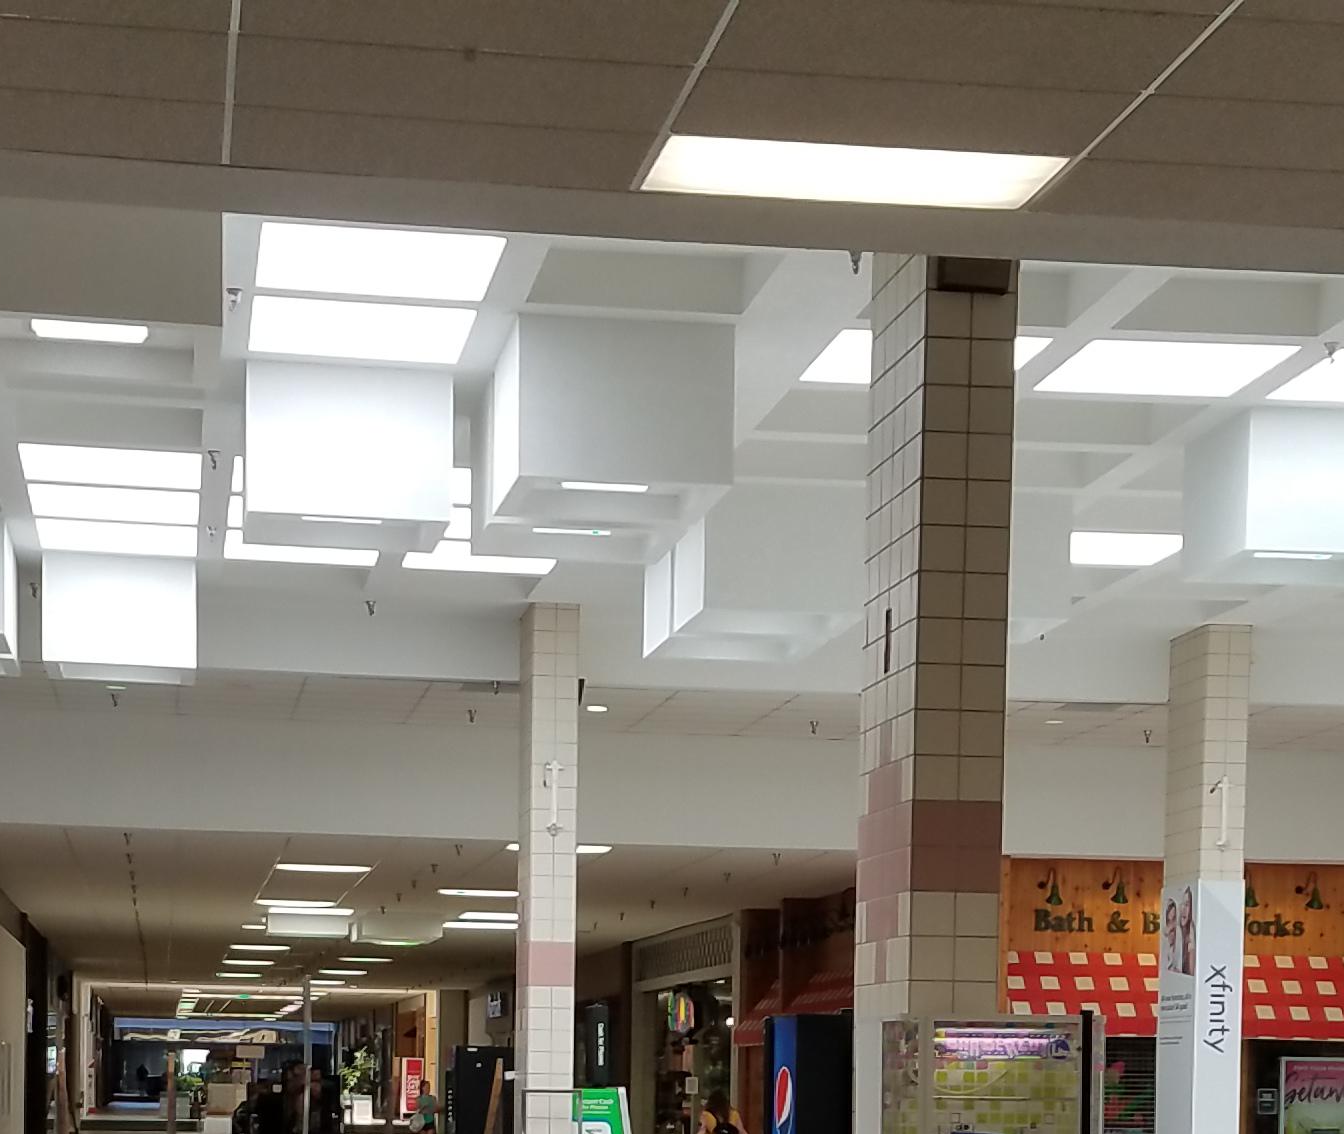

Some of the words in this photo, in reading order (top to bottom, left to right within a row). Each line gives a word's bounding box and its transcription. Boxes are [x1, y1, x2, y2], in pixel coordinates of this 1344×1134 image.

[1034, 909, 1095, 933] Bath
[1107, 910, 1130, 933] &
[1245, 913, 1306, 938] orks
[1202, 964, 1233, 1054] xfinity
